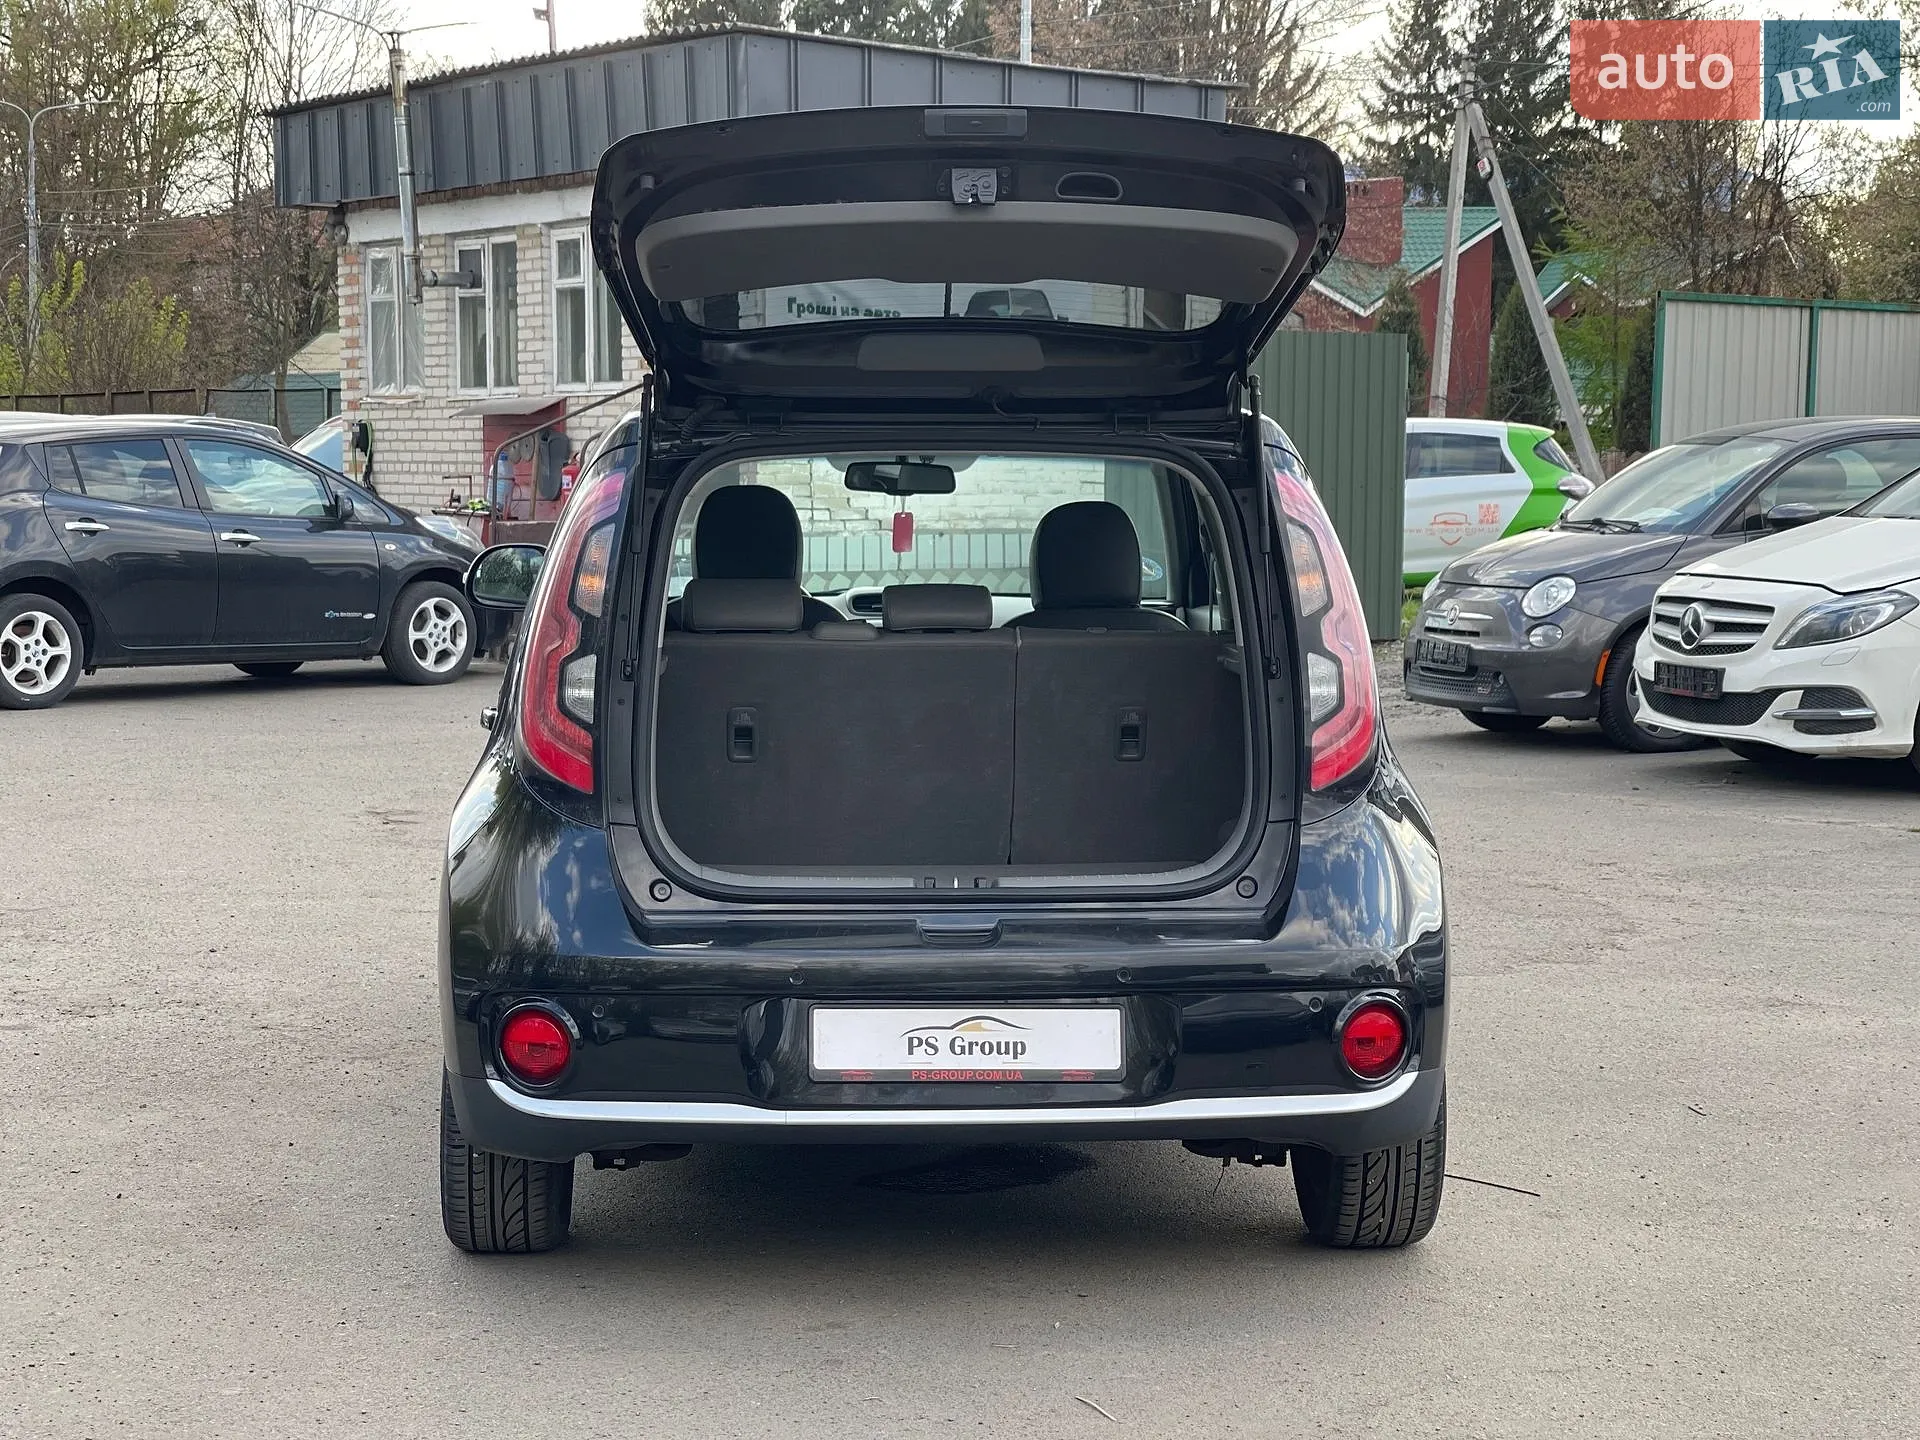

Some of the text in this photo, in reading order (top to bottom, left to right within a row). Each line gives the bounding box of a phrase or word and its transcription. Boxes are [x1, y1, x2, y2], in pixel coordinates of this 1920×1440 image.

[786, 295, 837, 318] Гроші
[907, 1036, 1027, 1060] PS Group
